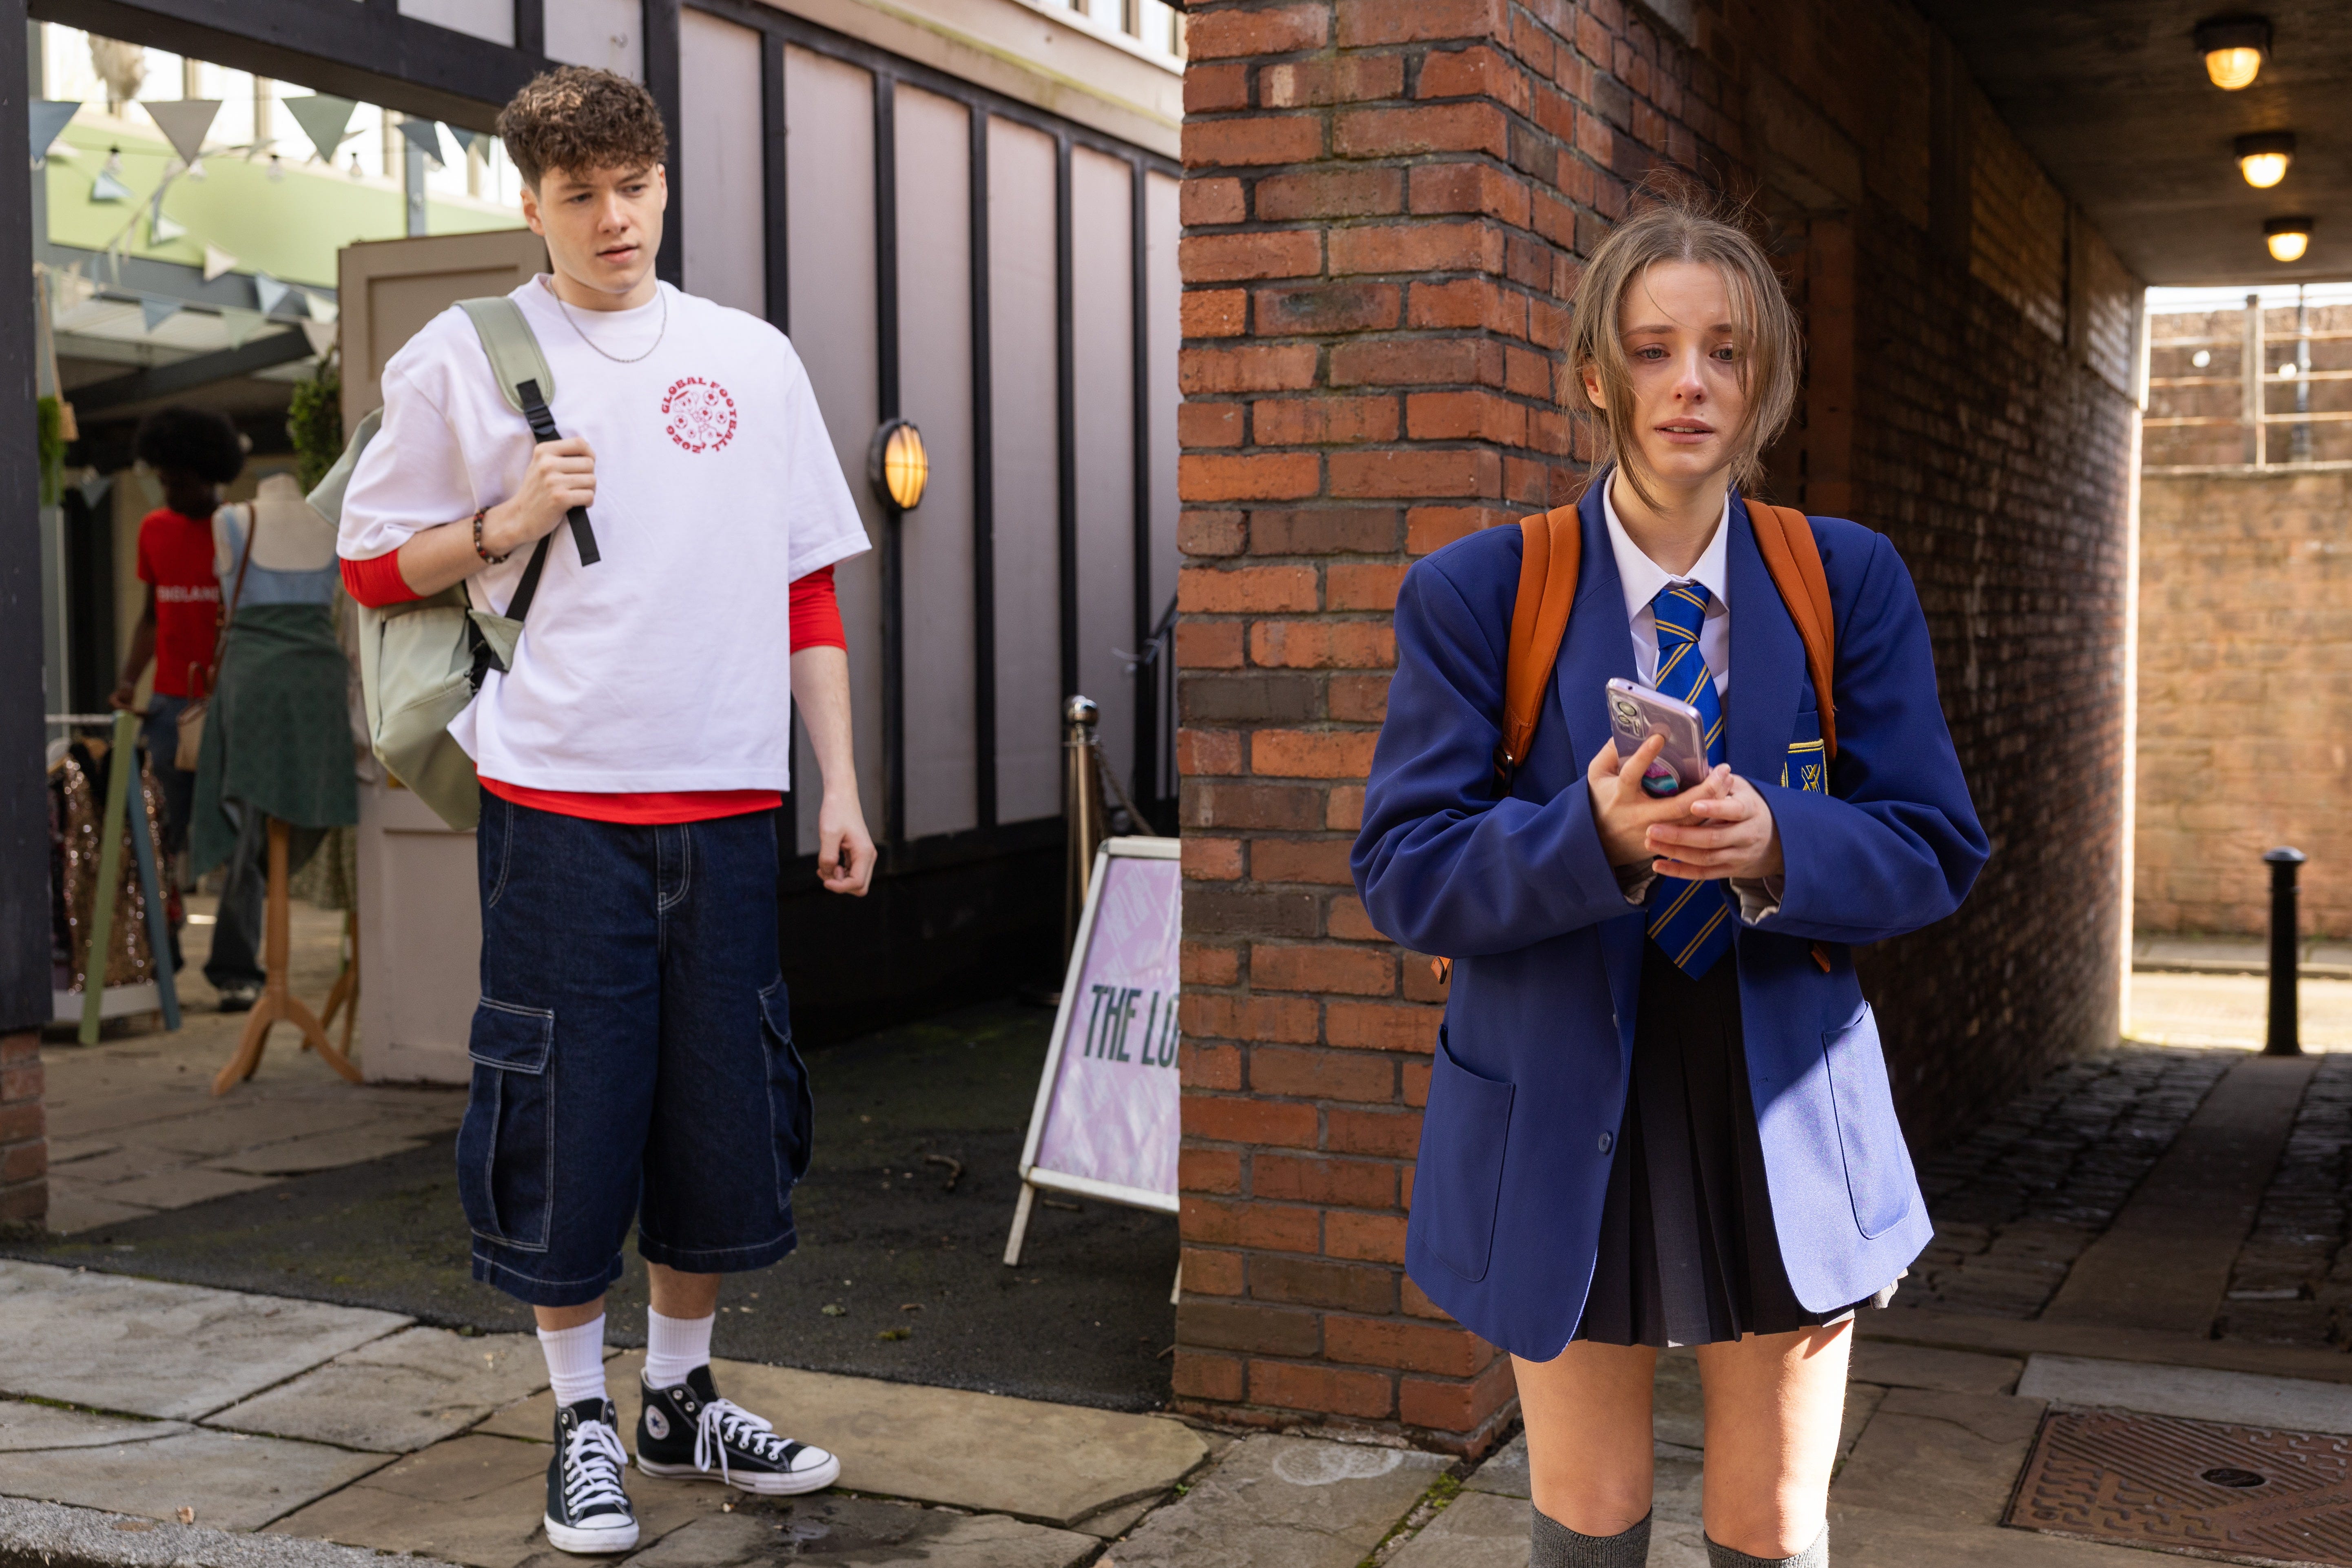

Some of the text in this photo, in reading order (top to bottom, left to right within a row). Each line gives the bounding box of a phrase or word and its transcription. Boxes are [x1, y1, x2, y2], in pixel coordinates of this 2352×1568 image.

[662, 376, 737, 454] GLOBAL FOOTBALL 2026
[1084, 984, 1180, 1068] THE LO
